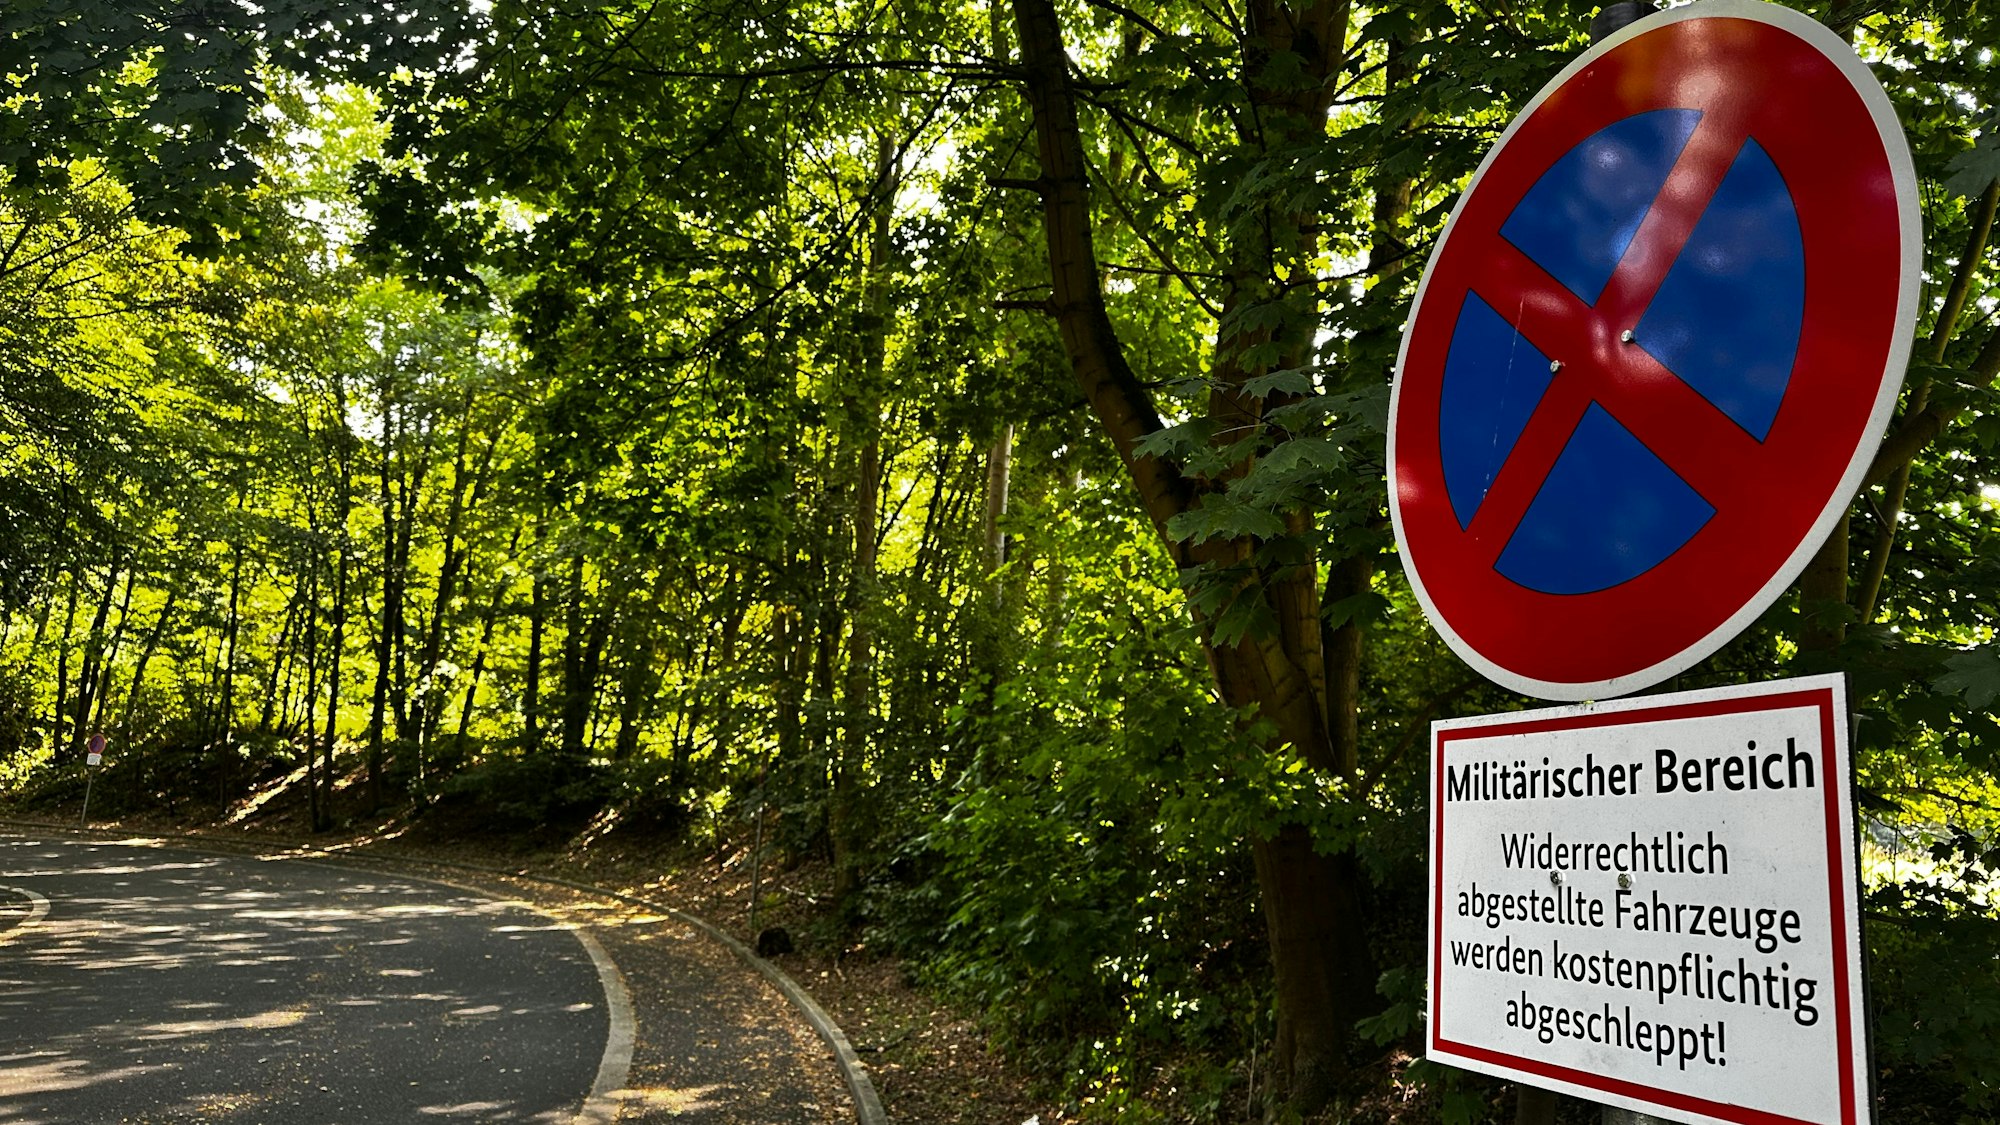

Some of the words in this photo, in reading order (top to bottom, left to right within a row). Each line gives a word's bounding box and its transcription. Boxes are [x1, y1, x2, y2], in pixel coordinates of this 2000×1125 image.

[1447, 753, 1643, 802] Militärischer
[1655, 737, 1815, 794] Bereich
[1501, 830, 1729, 875] Widerrechtlich
[1457, 882, 1604, 928] abgestellte
[1615, 889, 1802, 953] Fahrzeuge
[1450, 935, 1543, 976] werden
[1552, 939, 1819, 1026] kostenpflichtig
[1506, 990, 1727, 1071] abgeschleppt!
